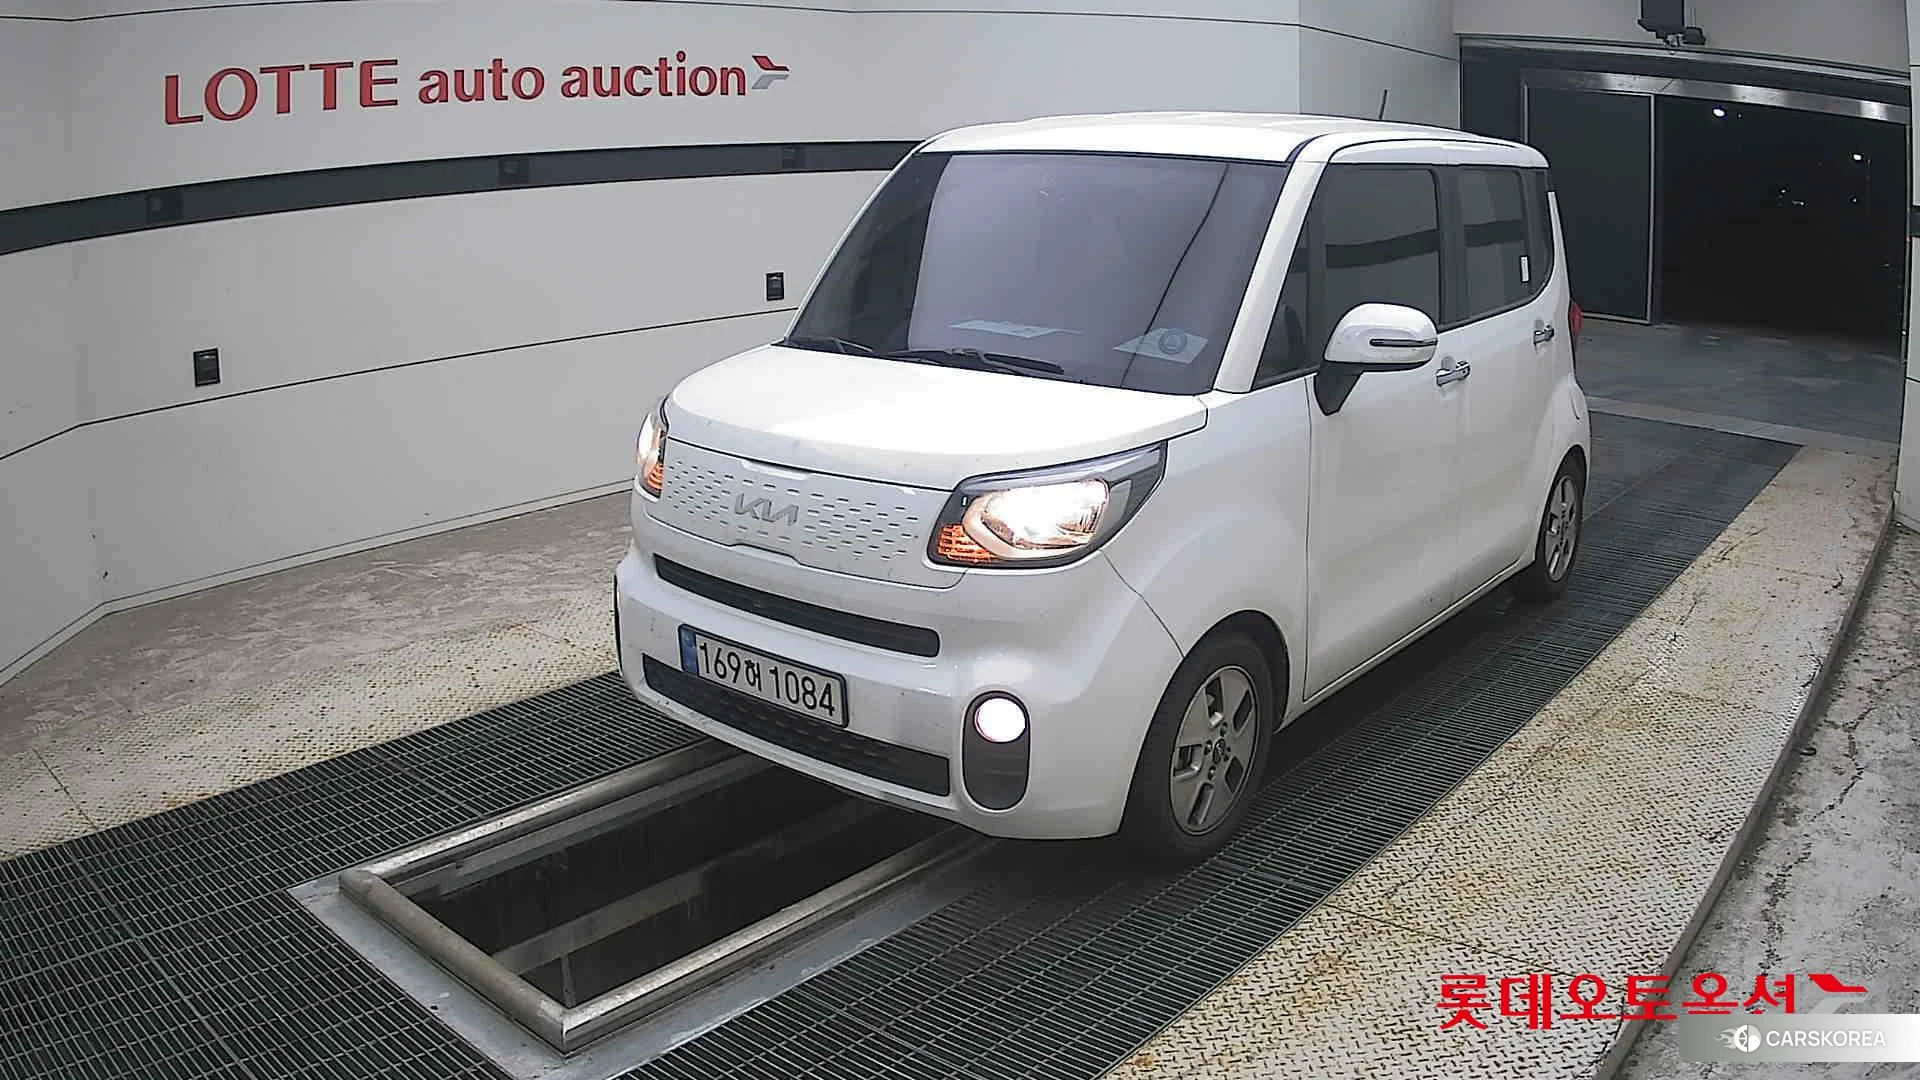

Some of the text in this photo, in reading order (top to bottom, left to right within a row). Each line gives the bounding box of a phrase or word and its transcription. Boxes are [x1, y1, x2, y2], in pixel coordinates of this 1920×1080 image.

[164, 50, 748, 125] LOTTE auto auction
[769, 666, 835, 717] 1084
